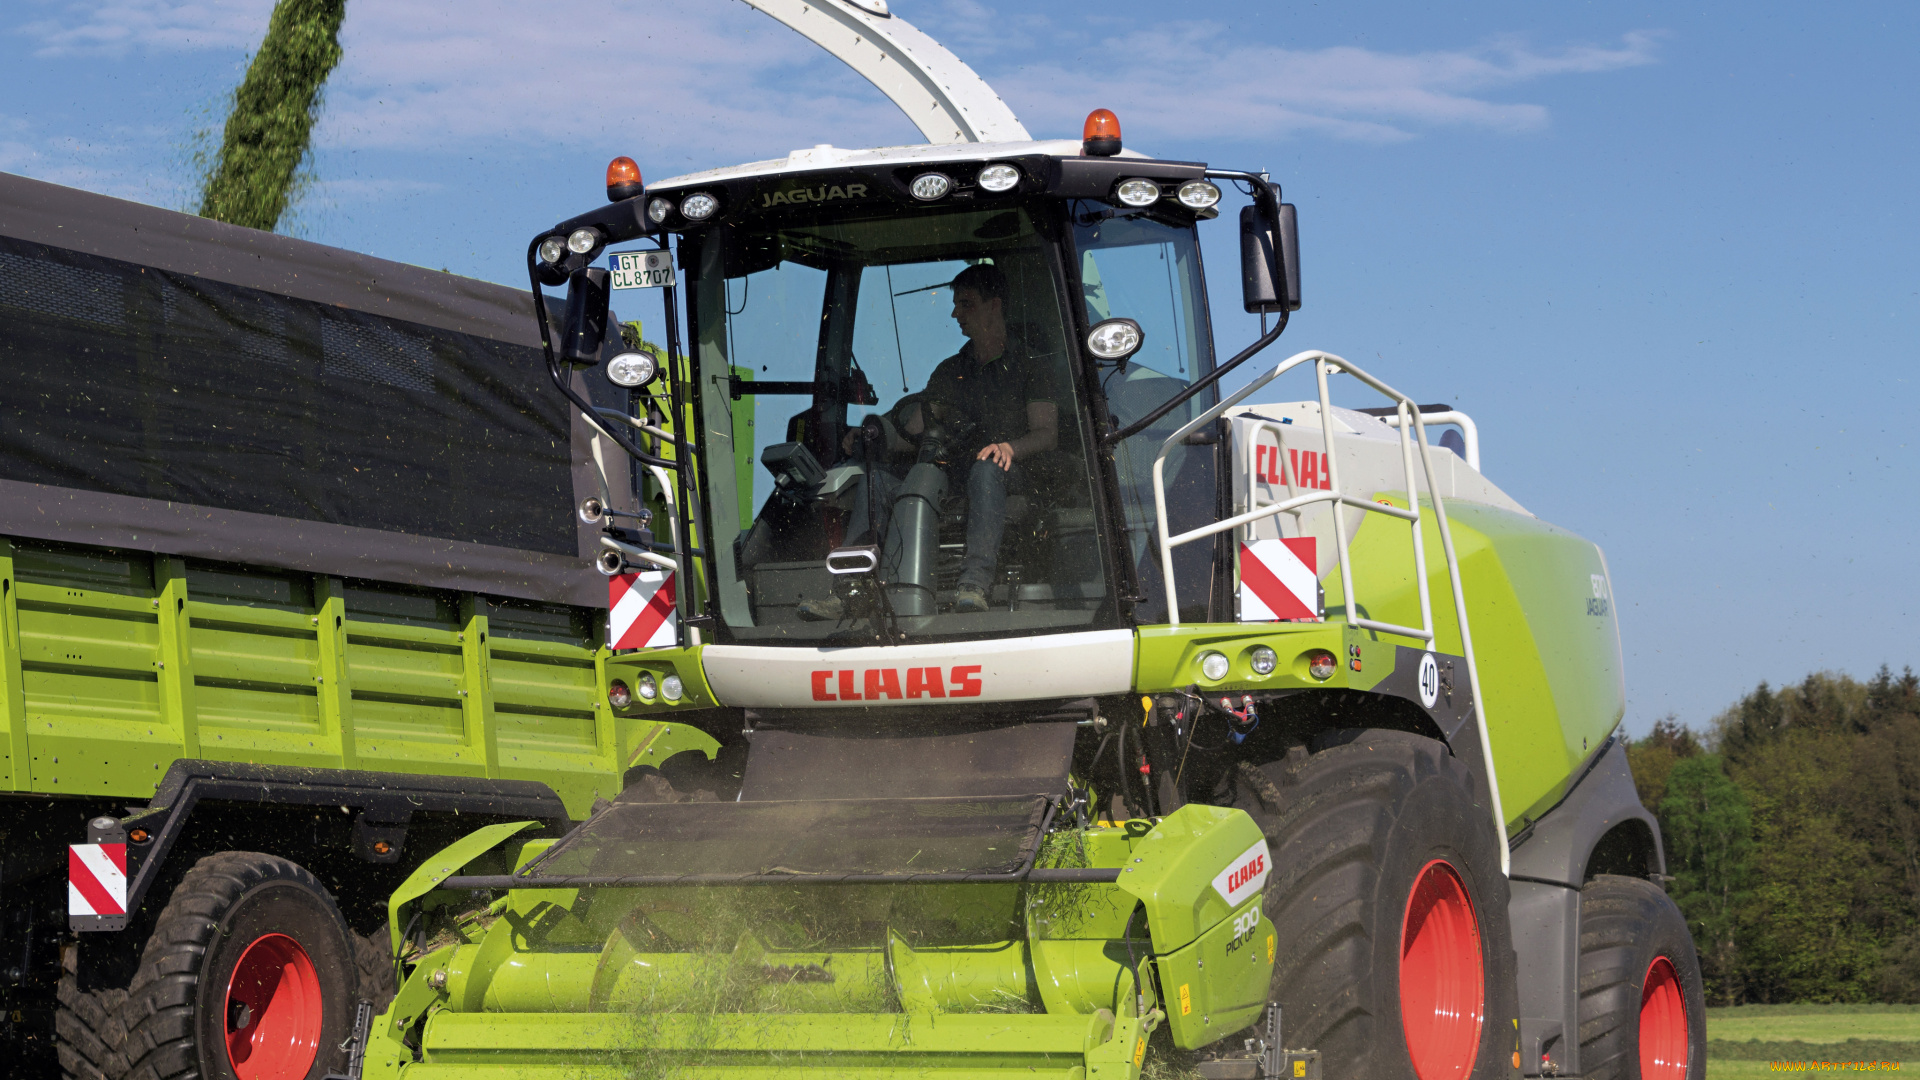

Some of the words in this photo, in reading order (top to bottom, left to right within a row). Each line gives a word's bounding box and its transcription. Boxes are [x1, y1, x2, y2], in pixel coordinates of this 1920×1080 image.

[762, 184, 868, 207] JAGUAR
[621, 255, 639, 270] GT
[811, 665, 982, 702] CLAAS
[1422, 662, 1435, 697] 40
[1228, 853, 1264, 894] CLAAS
[1233, 906, 1259, 940] 300
[1226, 933, 1243, 957] PICK
[1245, 926, 1256, 942] UP
